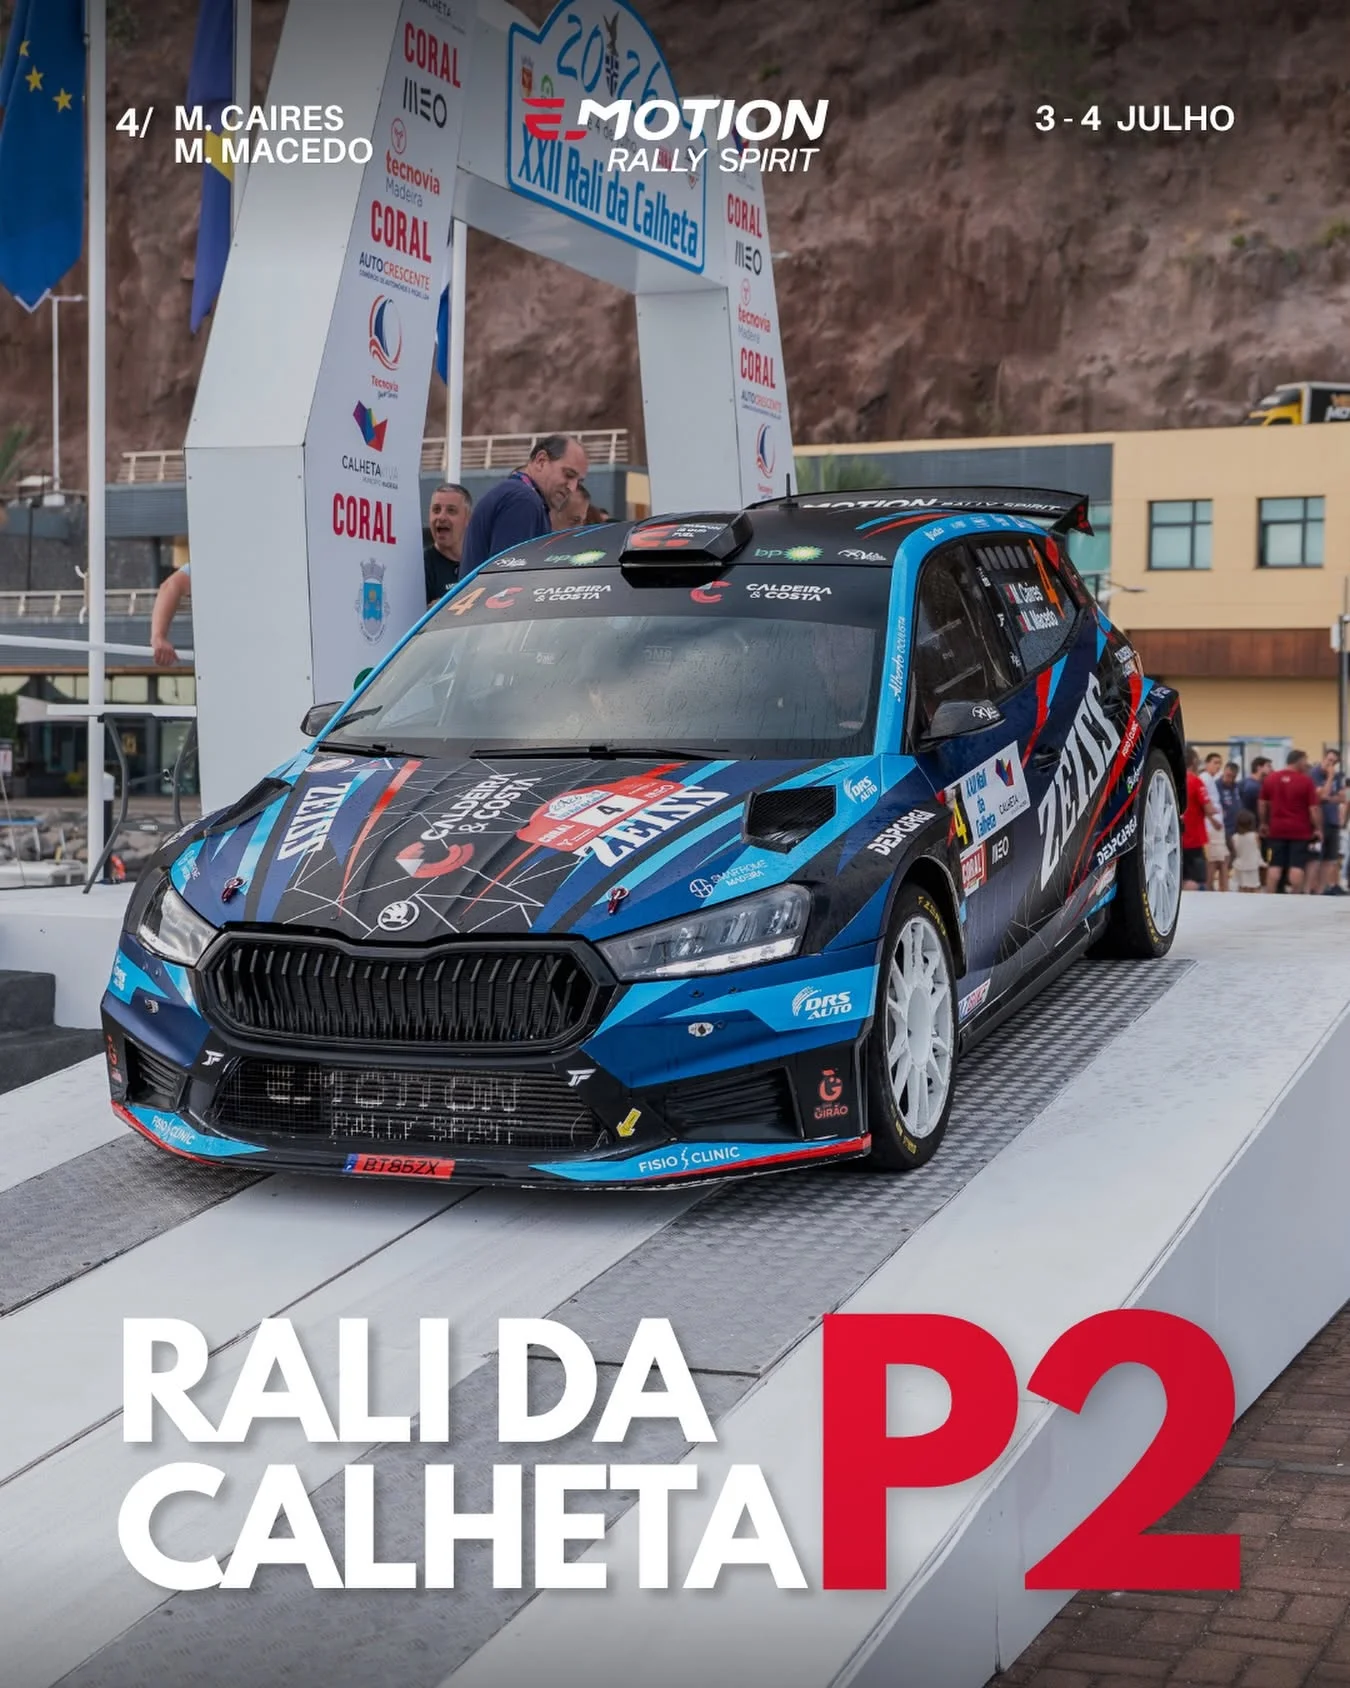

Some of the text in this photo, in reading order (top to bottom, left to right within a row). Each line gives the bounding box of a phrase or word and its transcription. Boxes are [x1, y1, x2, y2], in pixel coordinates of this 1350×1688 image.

[404, 22, 461, 88] CORAL
[403, 77, 447, 128] MEO
[386, 151, 440, 196] tecnovia
[385, 178, 424, 208] Madeira
[518, 123, 698, 258] XXII Rali da Calheta
[727, 192, 762, 240] CORAL
[371, 200, 432, 264] CORAL
[735, 240, 762, 276] MEO
[738, 304, 771, 333] tecnovia
[740, 348, 776, 389] CORAL
[332, 492, 397, 545] CORAL
[544, 554, 571, 564] bp
[755, 549, 782, 560] bp
[448, 587, 486, 616] 4
[533, 585, 613, 596] CALDEIRA
[549, 593, 601, 602] COSTA
[746, 583, 832, 595] CALDEIRA
[765, 592, 822, 601] COSTA
[851, 776, 873, 797] DRS
[860, 783, 878, 804] AUTO
[1038, 672, 1121, 892] ZEISS
[421, 772, 519, 840] CALDEIRA
[472, 777, 543, 819] COSTA
[596, 805, 625, 816] 4
[277, 782, 353, 860] ZEISS
[572, 785, 730, 867] ZEISS
[992, 836, 1009, 864] MEO
[804, 991, 851, 1011] DRS
[807, 1004, 852, 1020] AUTO
[814, 1104, 848, 1119] GIRÃO
[171, 1125, 196, 1145] CLINIC
[639, 1147, 740, 1173] FISIO CLINIC
